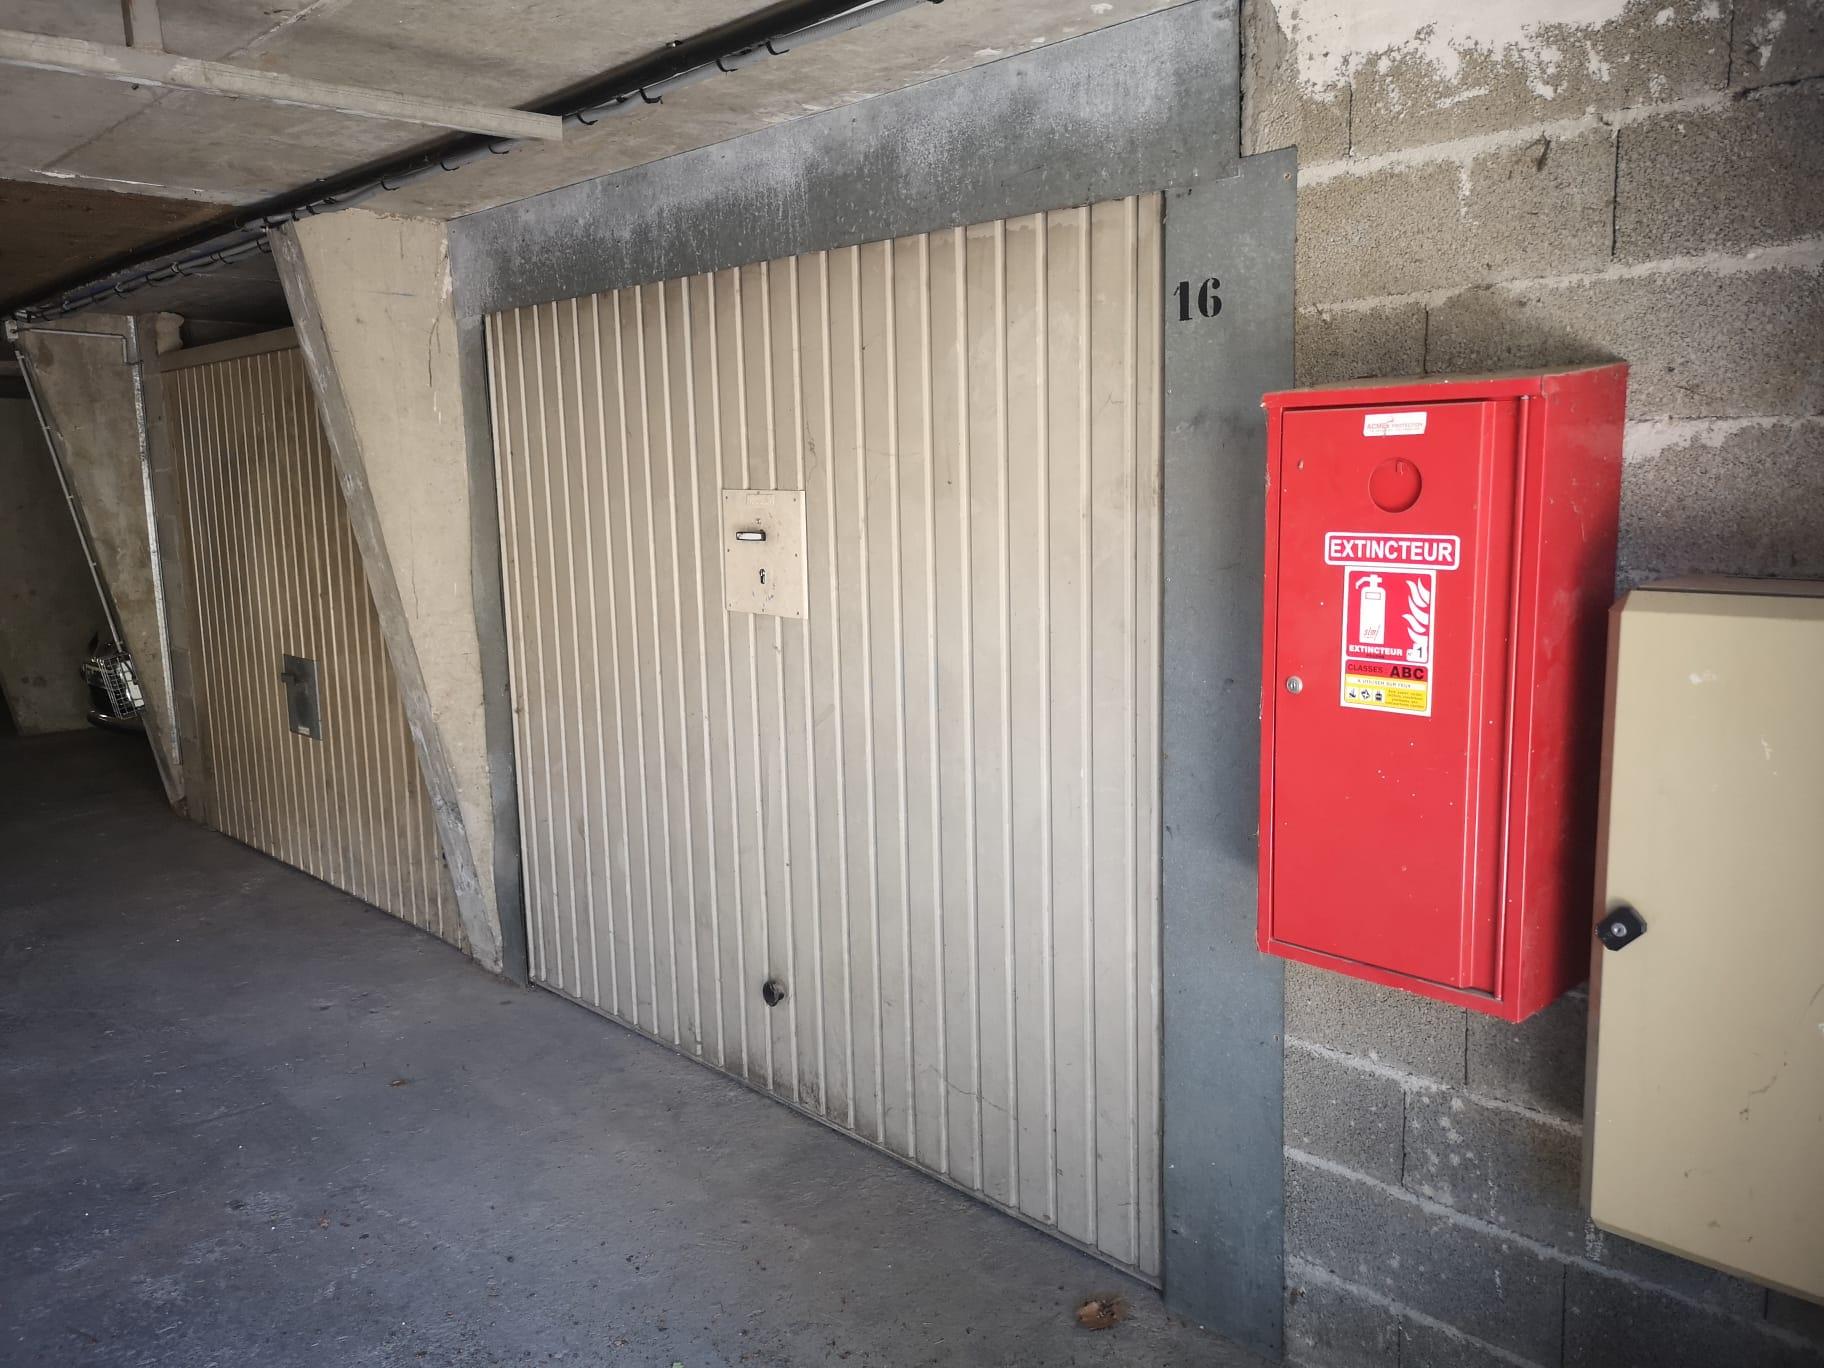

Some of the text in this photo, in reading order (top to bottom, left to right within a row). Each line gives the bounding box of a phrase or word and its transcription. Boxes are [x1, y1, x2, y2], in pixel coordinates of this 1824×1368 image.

[1173, 277, 1222, 321] 16
[1330, 539, 1453, 562] EXTINCTEUR
[1348, 644, 1403, 657] EXTINCTEUR
[1347, 663, 1424, 680] CLASSES ABC
